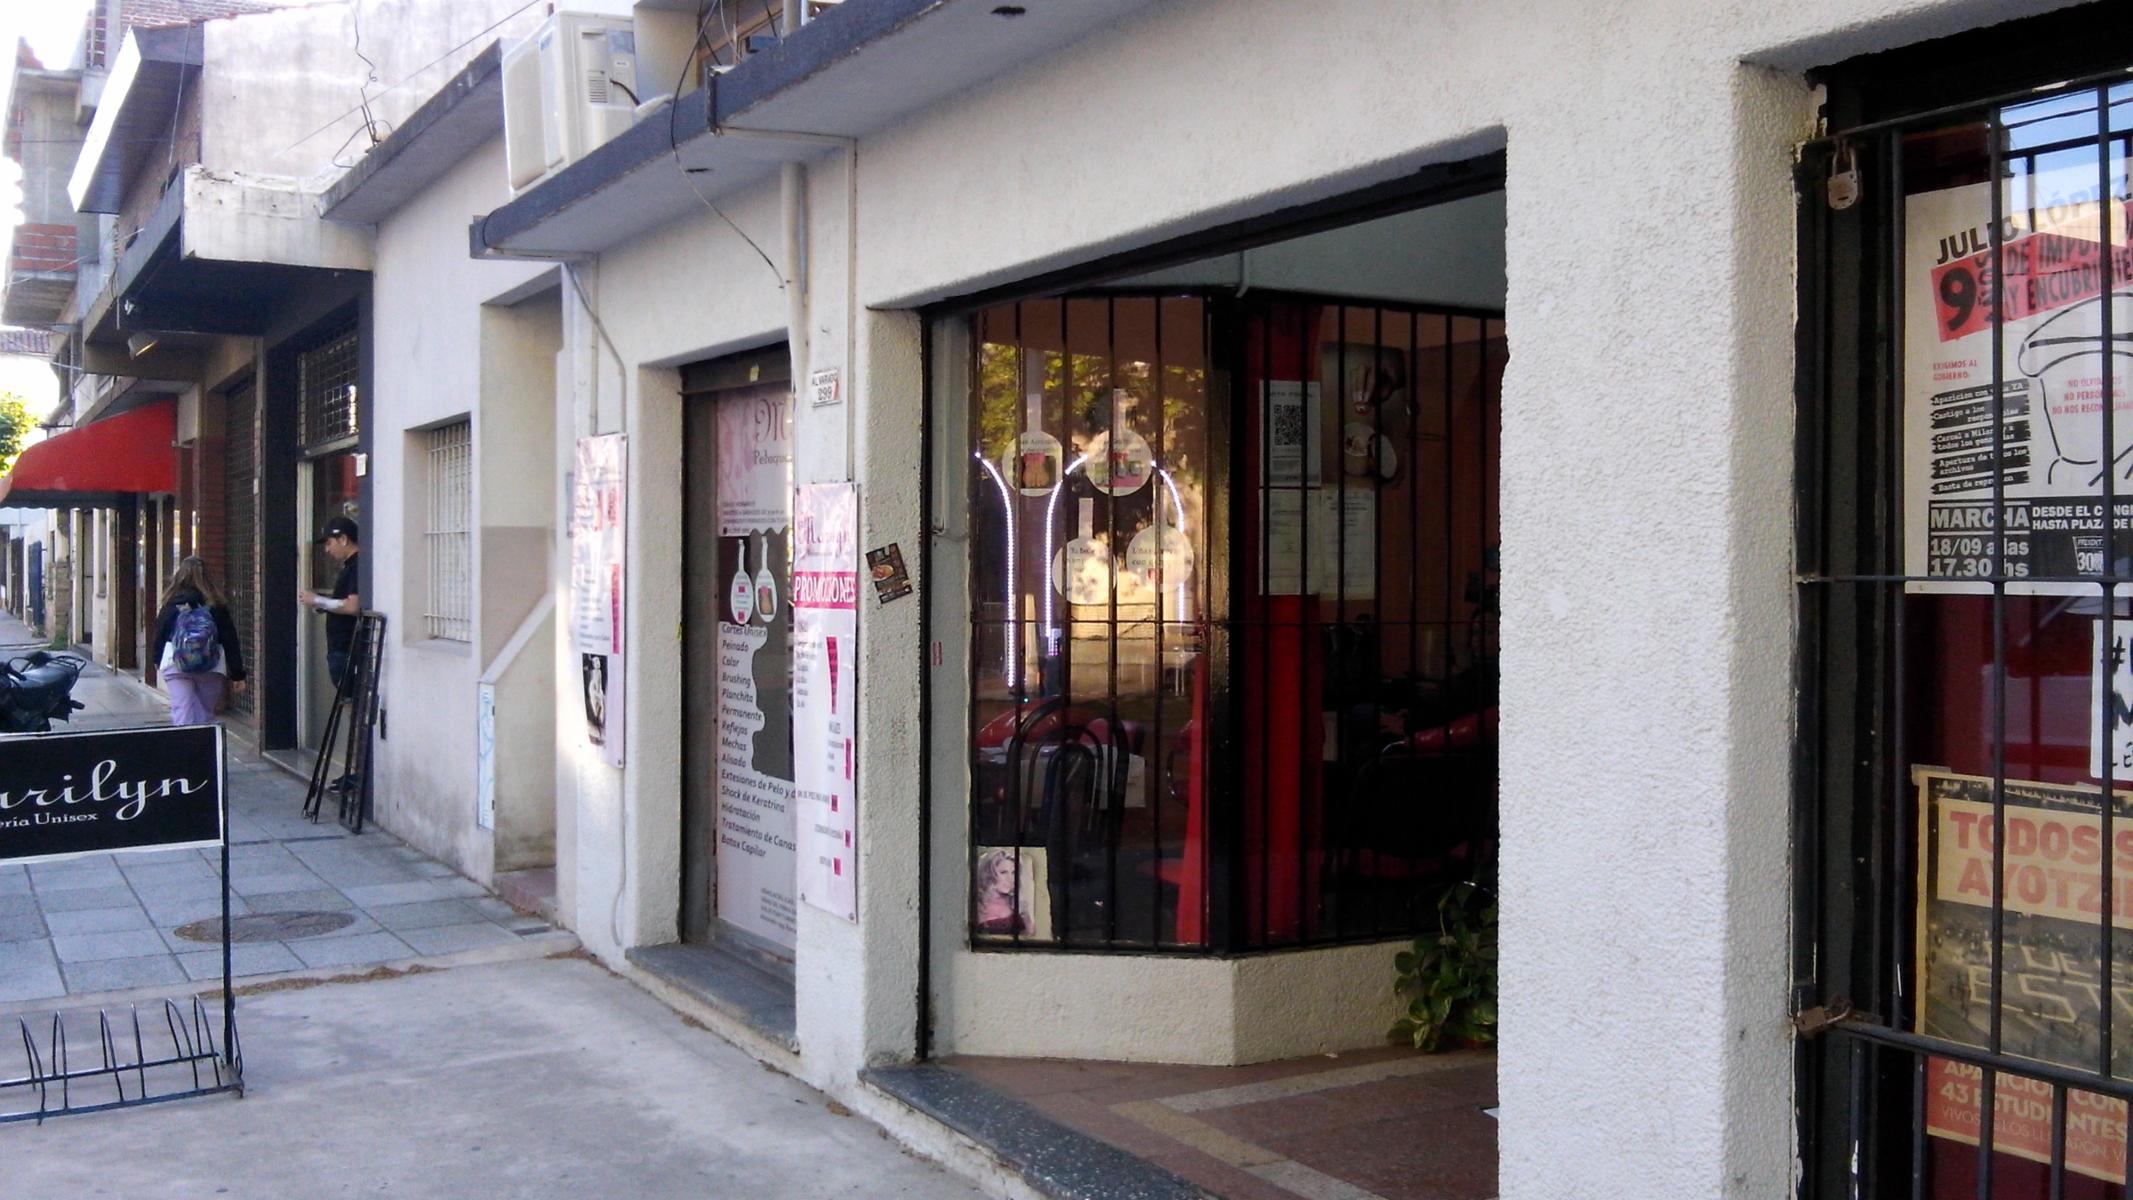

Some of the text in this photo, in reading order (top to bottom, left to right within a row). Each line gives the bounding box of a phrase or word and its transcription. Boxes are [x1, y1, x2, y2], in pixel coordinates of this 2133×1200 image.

[1940, 267, 1977, 331] 9
[1930, 507, 2030, 528] MARCHA
[2032, 504, 2133, 517] DESDE EL CNG
[2032, 519, 2069, 530] HASTA
[1930, 538, 1982, 556] 18/09
[2003, 538, 2029, 556] las
[1930, 557, 2029, 577] 17.30 hs
[742, 791, 751, 802] de
[758, 779, 767, 790] de
[768, 782, 784, 795] Pelo
[34, 812, 98, 825] Unisex
[721, 817, 797, 852] Tratamiento de Canas
[1951, 810, 2103, 866] TODOS
[1940, 1081, 2128, 1144] 43 ETUDINTES
